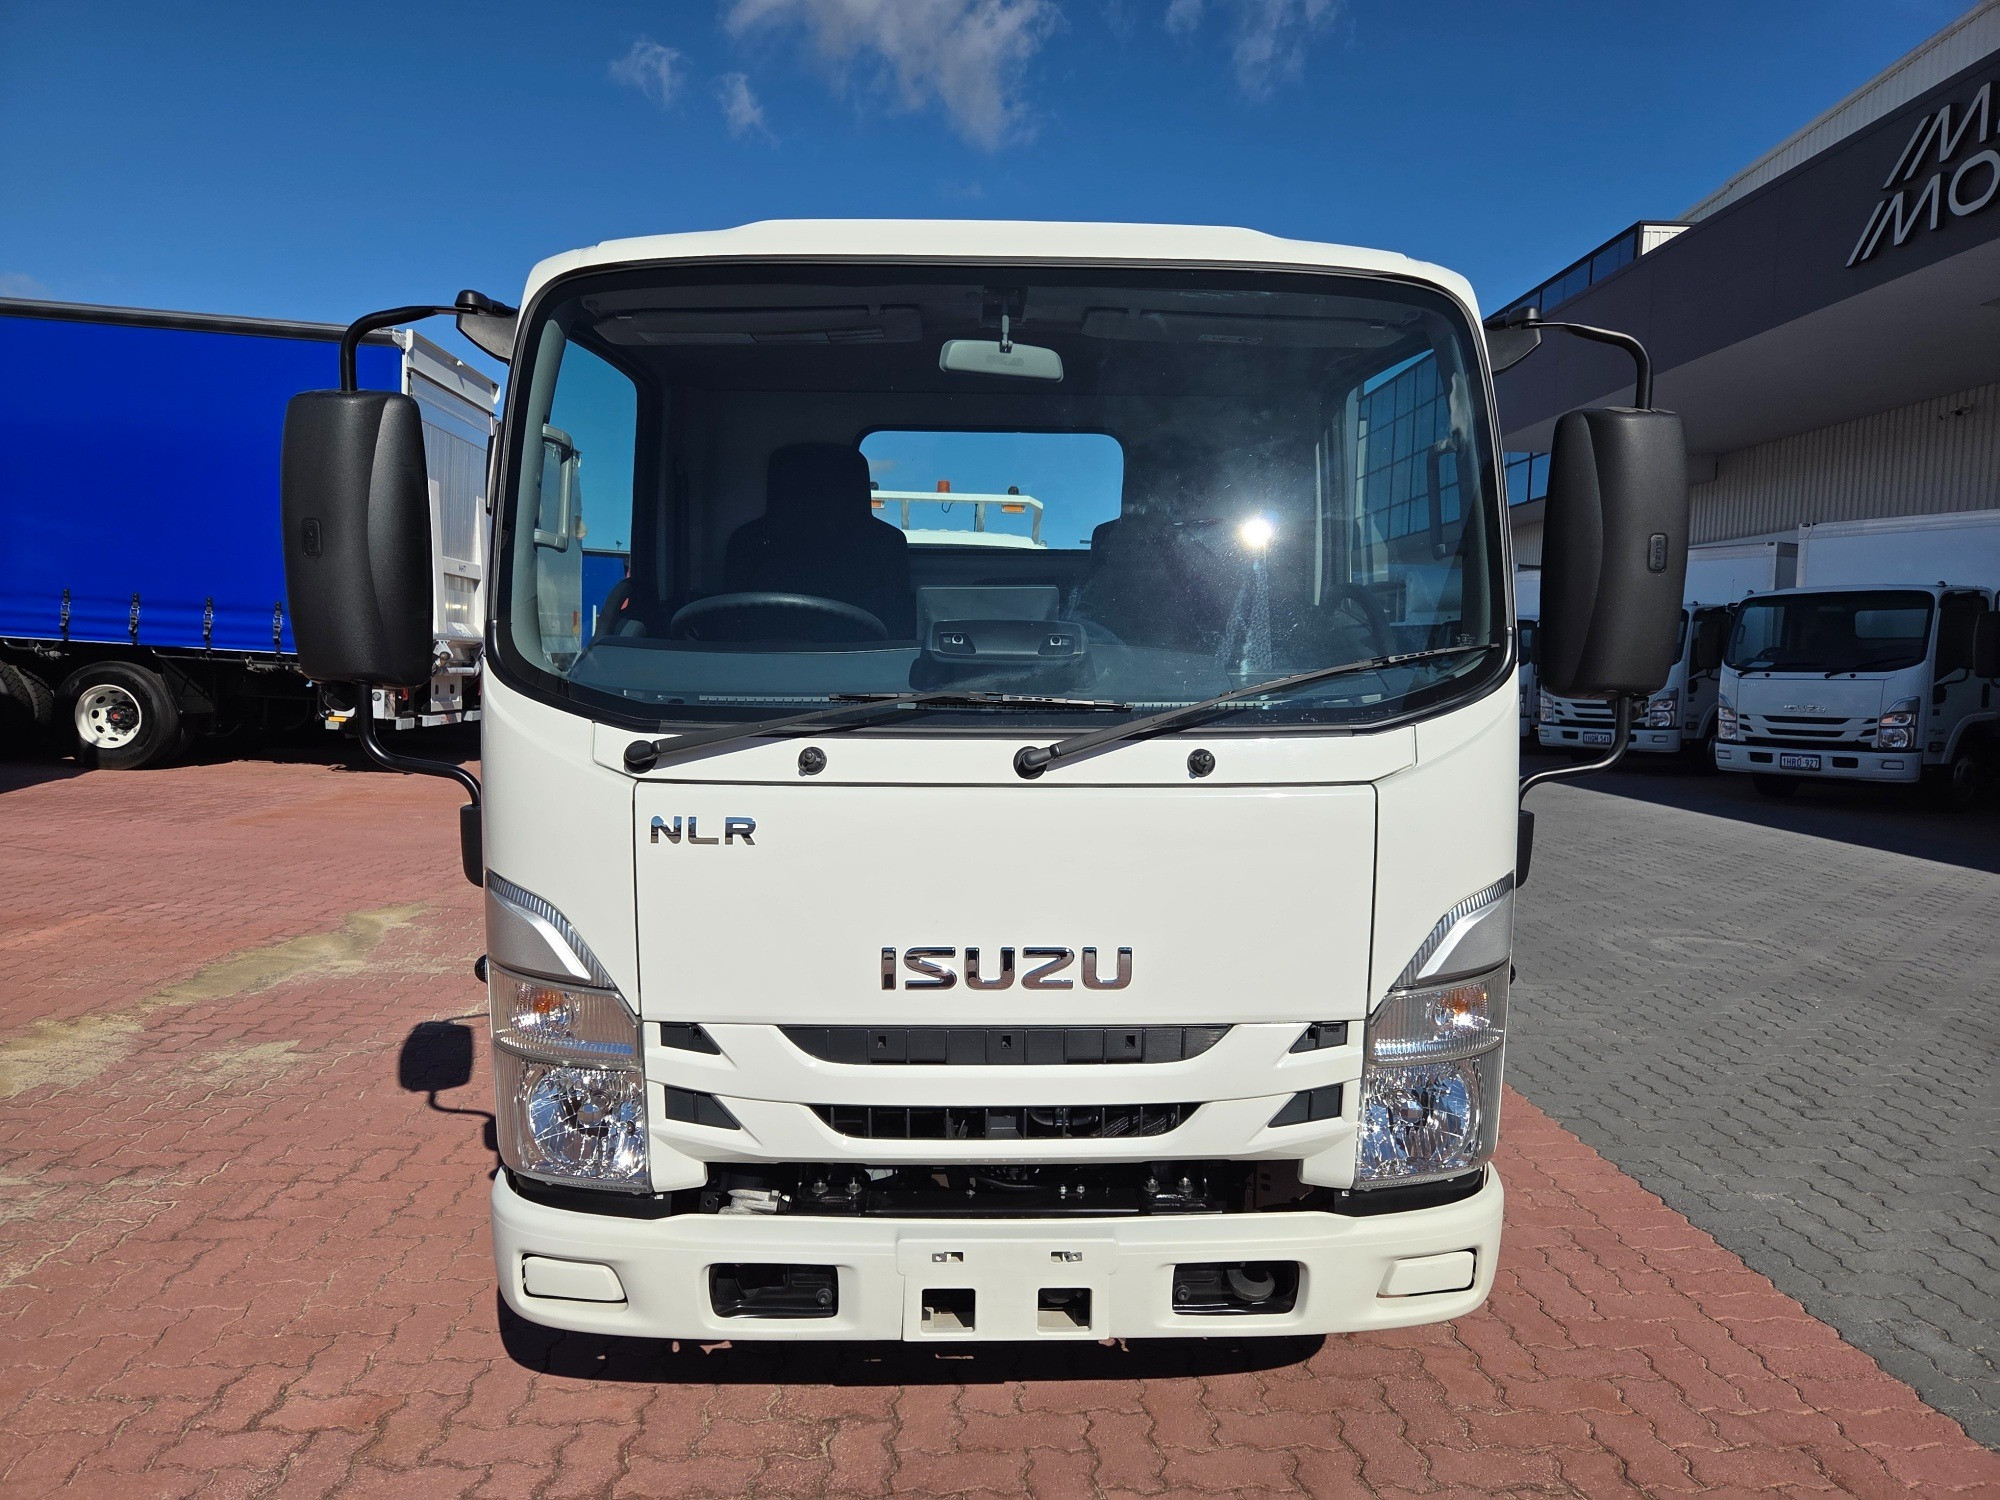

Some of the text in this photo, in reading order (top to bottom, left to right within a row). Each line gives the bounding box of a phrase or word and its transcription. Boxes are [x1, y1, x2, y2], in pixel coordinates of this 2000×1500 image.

[1784, 704, 1827, 714] ISUZU
[650, 815, 757, 846] NLR
[881, 946, 1133, 991] ISUZU
